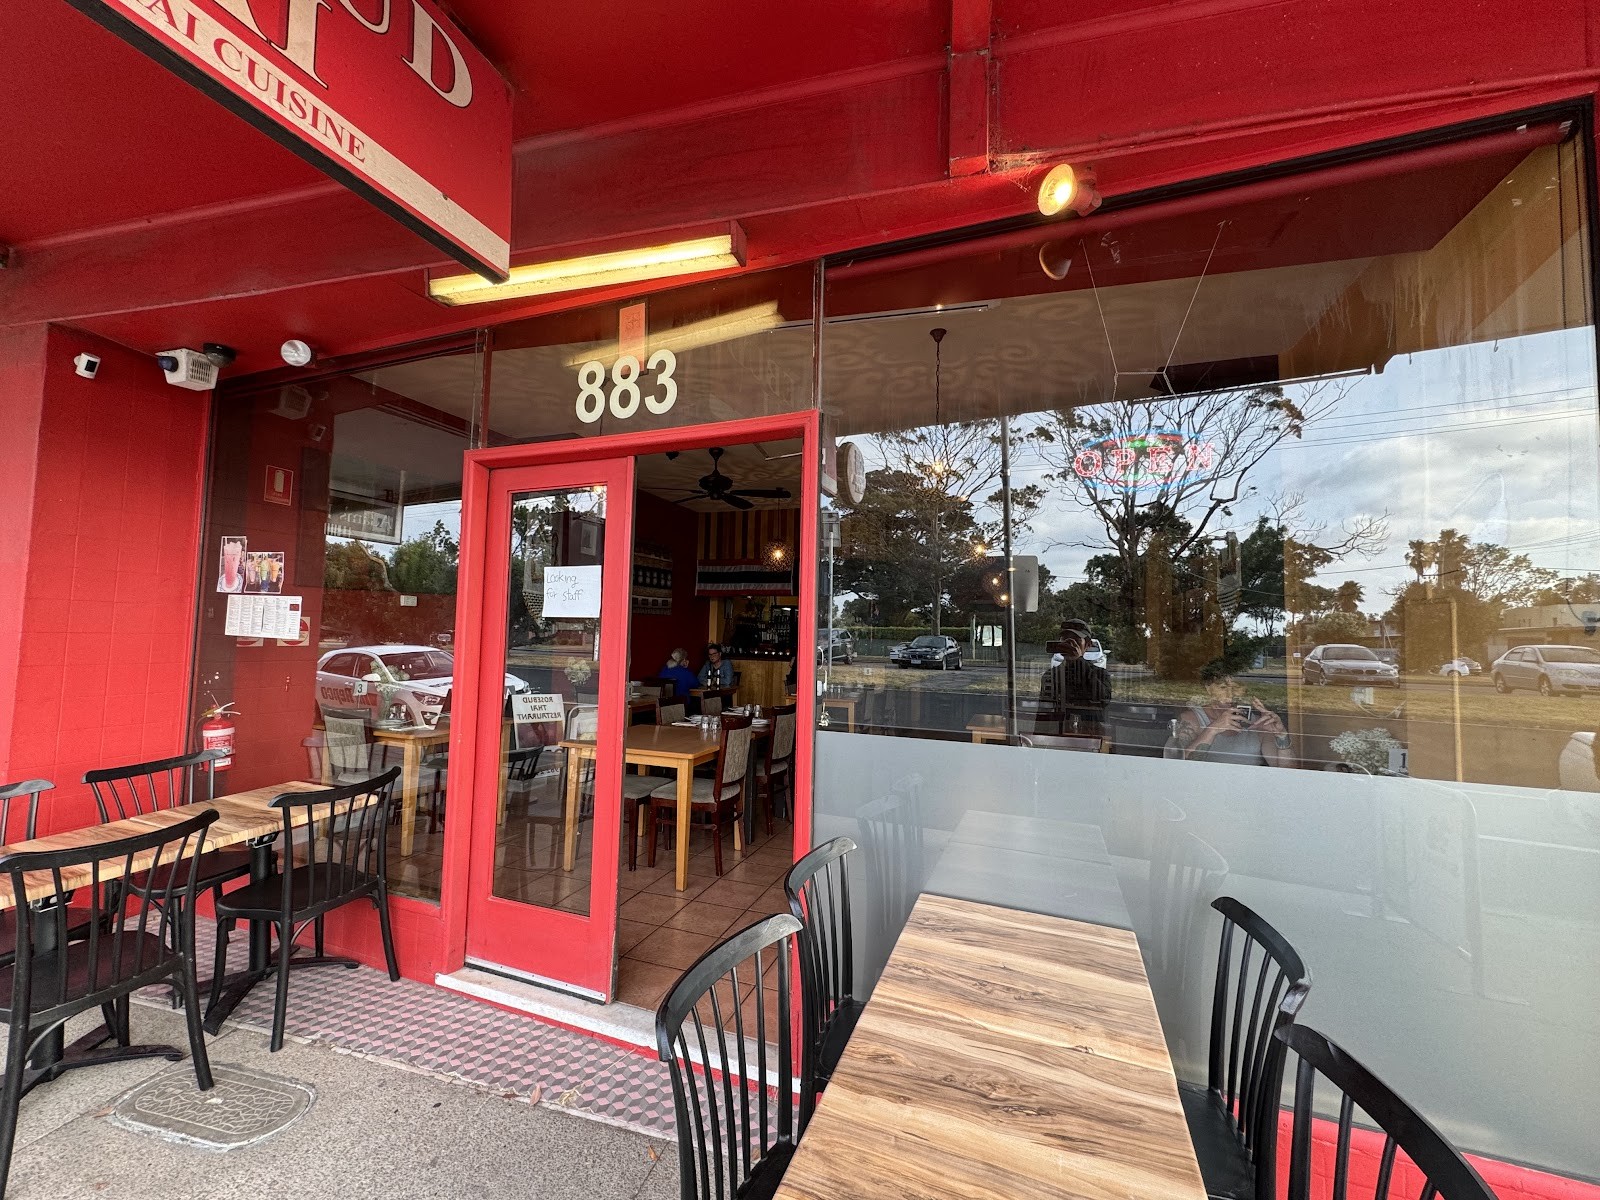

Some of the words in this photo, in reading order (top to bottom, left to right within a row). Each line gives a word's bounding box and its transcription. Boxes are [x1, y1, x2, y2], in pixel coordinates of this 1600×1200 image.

[136, 0, 199, 45] AI
[213, 37, 366, 164] CUISINE
[575, 349, 678, 424] 883
[1073, 442, 1216, 478] OPEN
[546, 570, 579, 589] Looking
[546, 587, 557, 599] for
[562, 588, 584, 602] staff
[357, 683, 363, 694] 3
